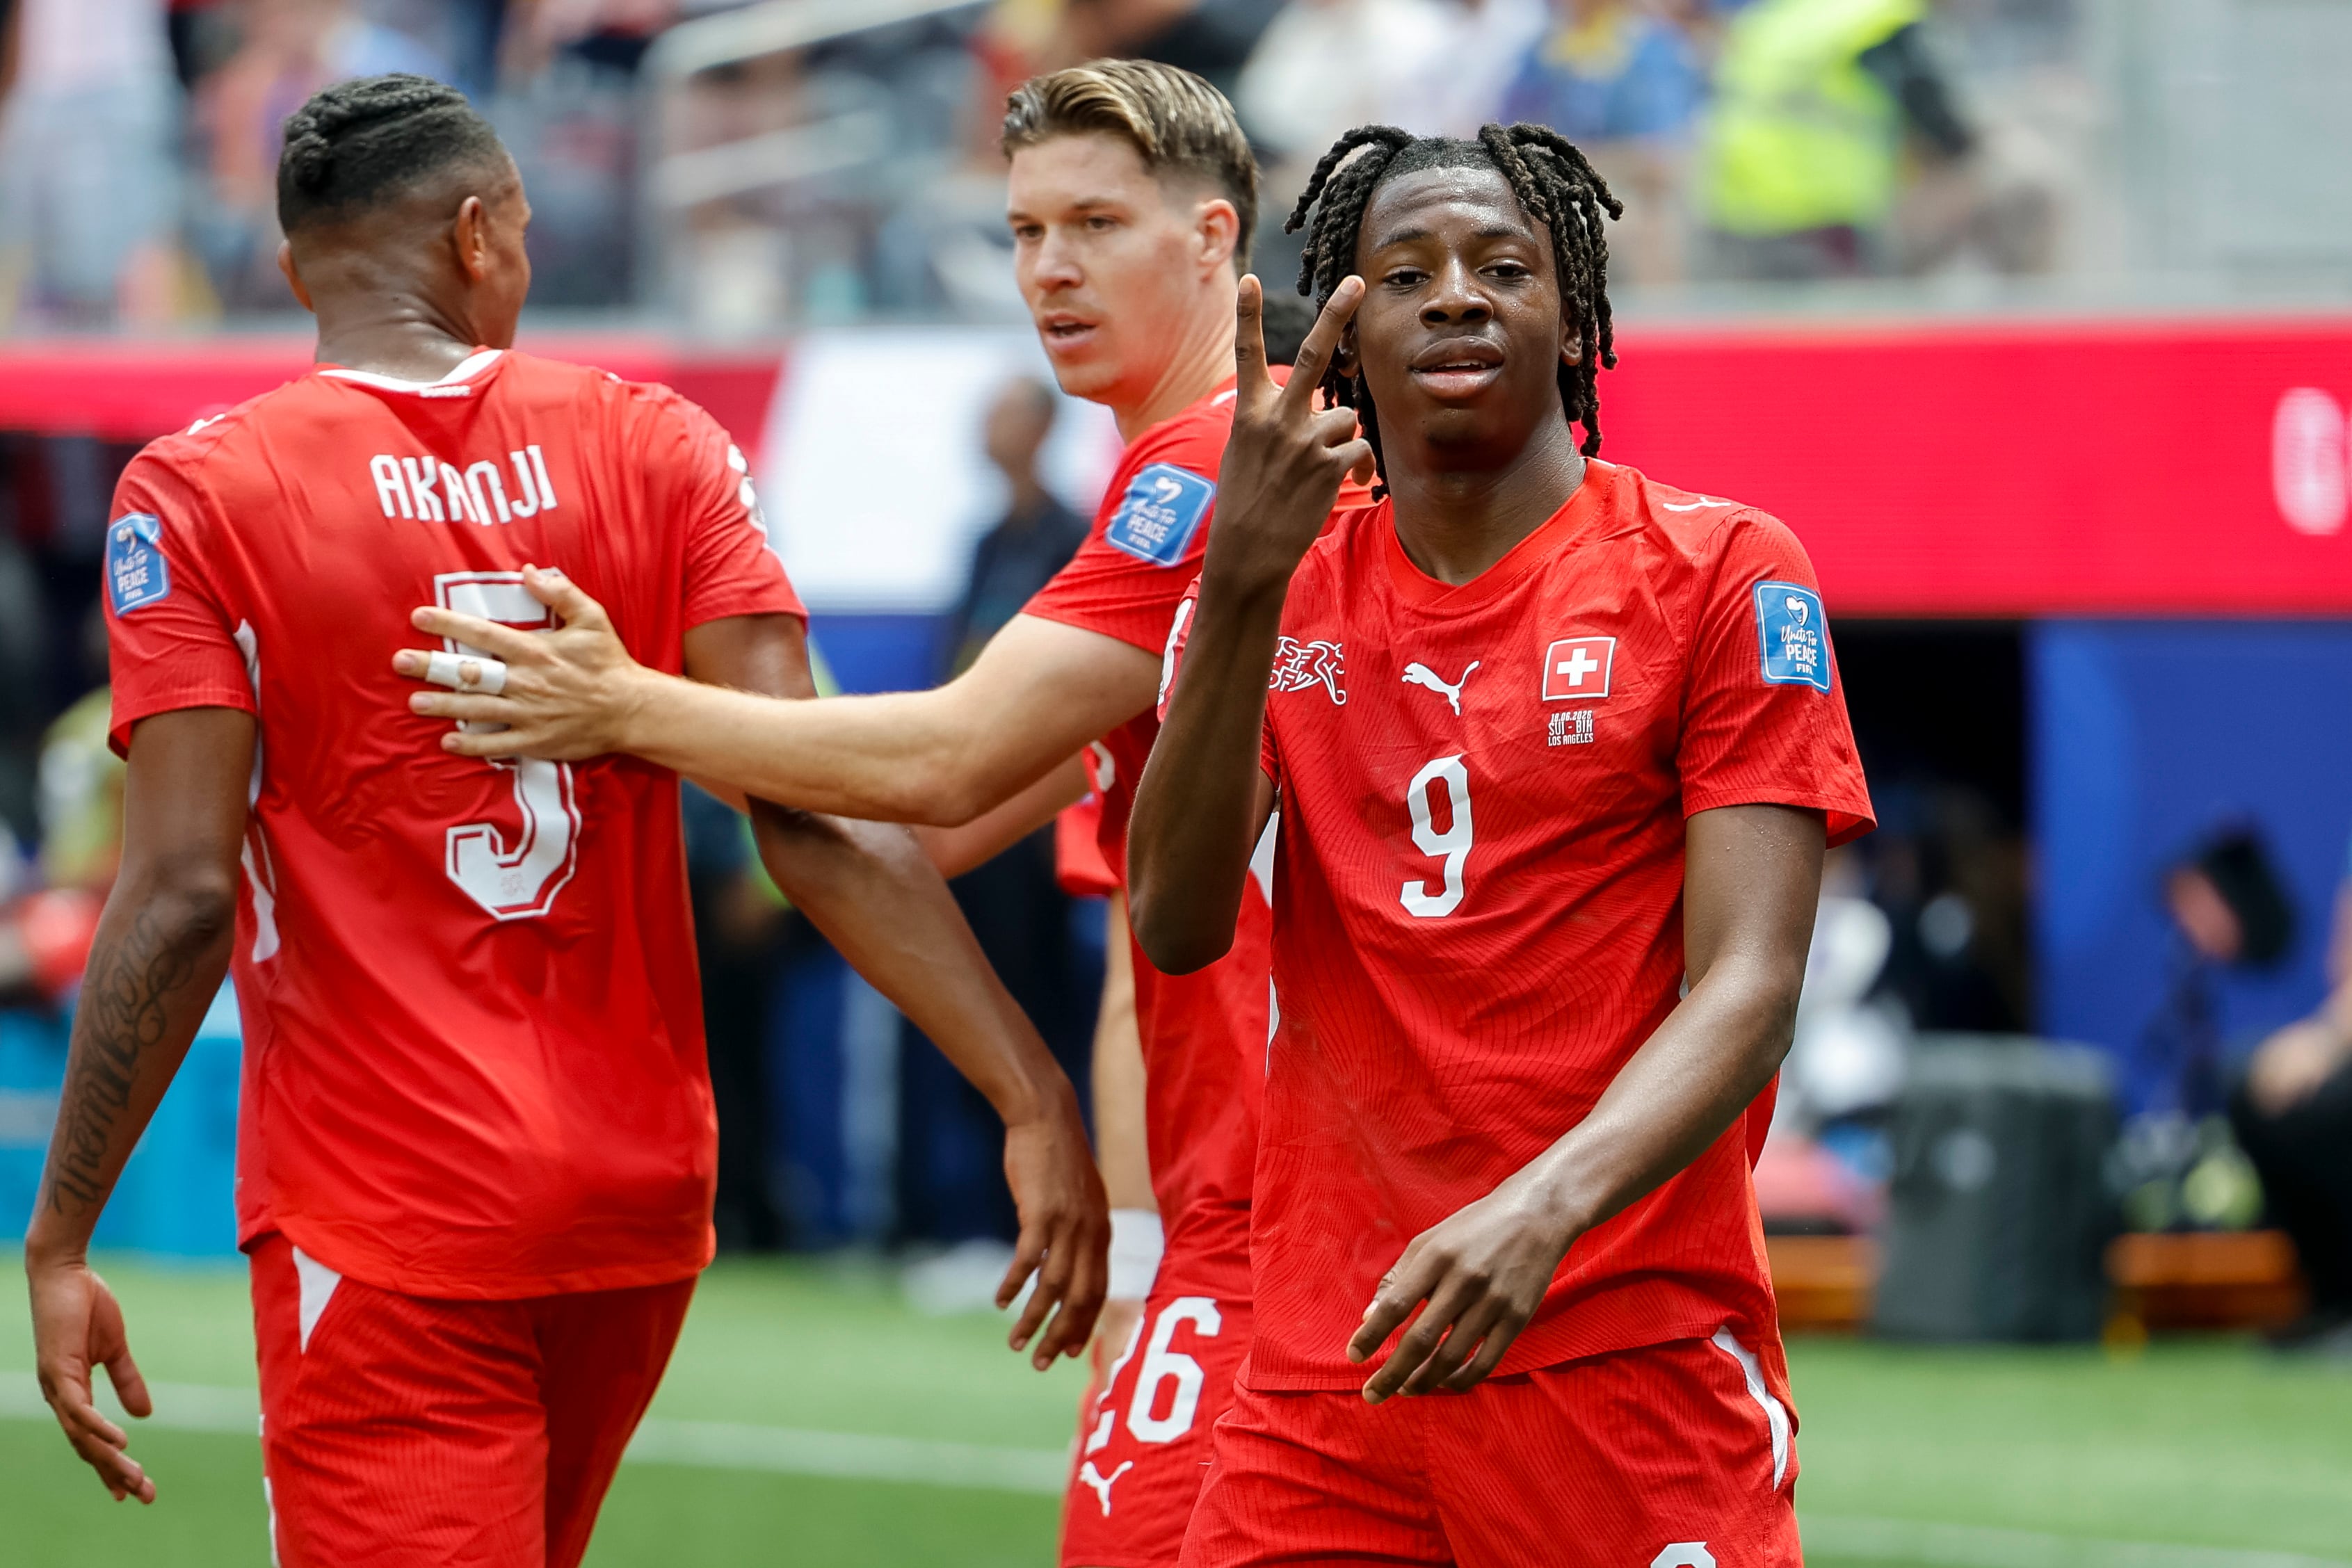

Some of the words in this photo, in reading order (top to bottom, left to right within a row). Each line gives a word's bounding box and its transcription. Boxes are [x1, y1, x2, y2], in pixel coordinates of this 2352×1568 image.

[369, 444, 558, 526] AKANJI
[1126, 513, 1169, 544] PEACE
[118, 565, 150, 595] PEACE
[1781, 624, 1807, 645] Unite
[1806, 630, 1818, 647] For
[1785, 643, 1818, 668] PEACE
[1548, 721, 1565, 736] SUI
[1575, 719, 1593, 734] BIH
[1548, 736, 1561, 747] LOS
[1563, 733, 1594, 745] ANGELES
[1399, 753, 1474, 917] 9
